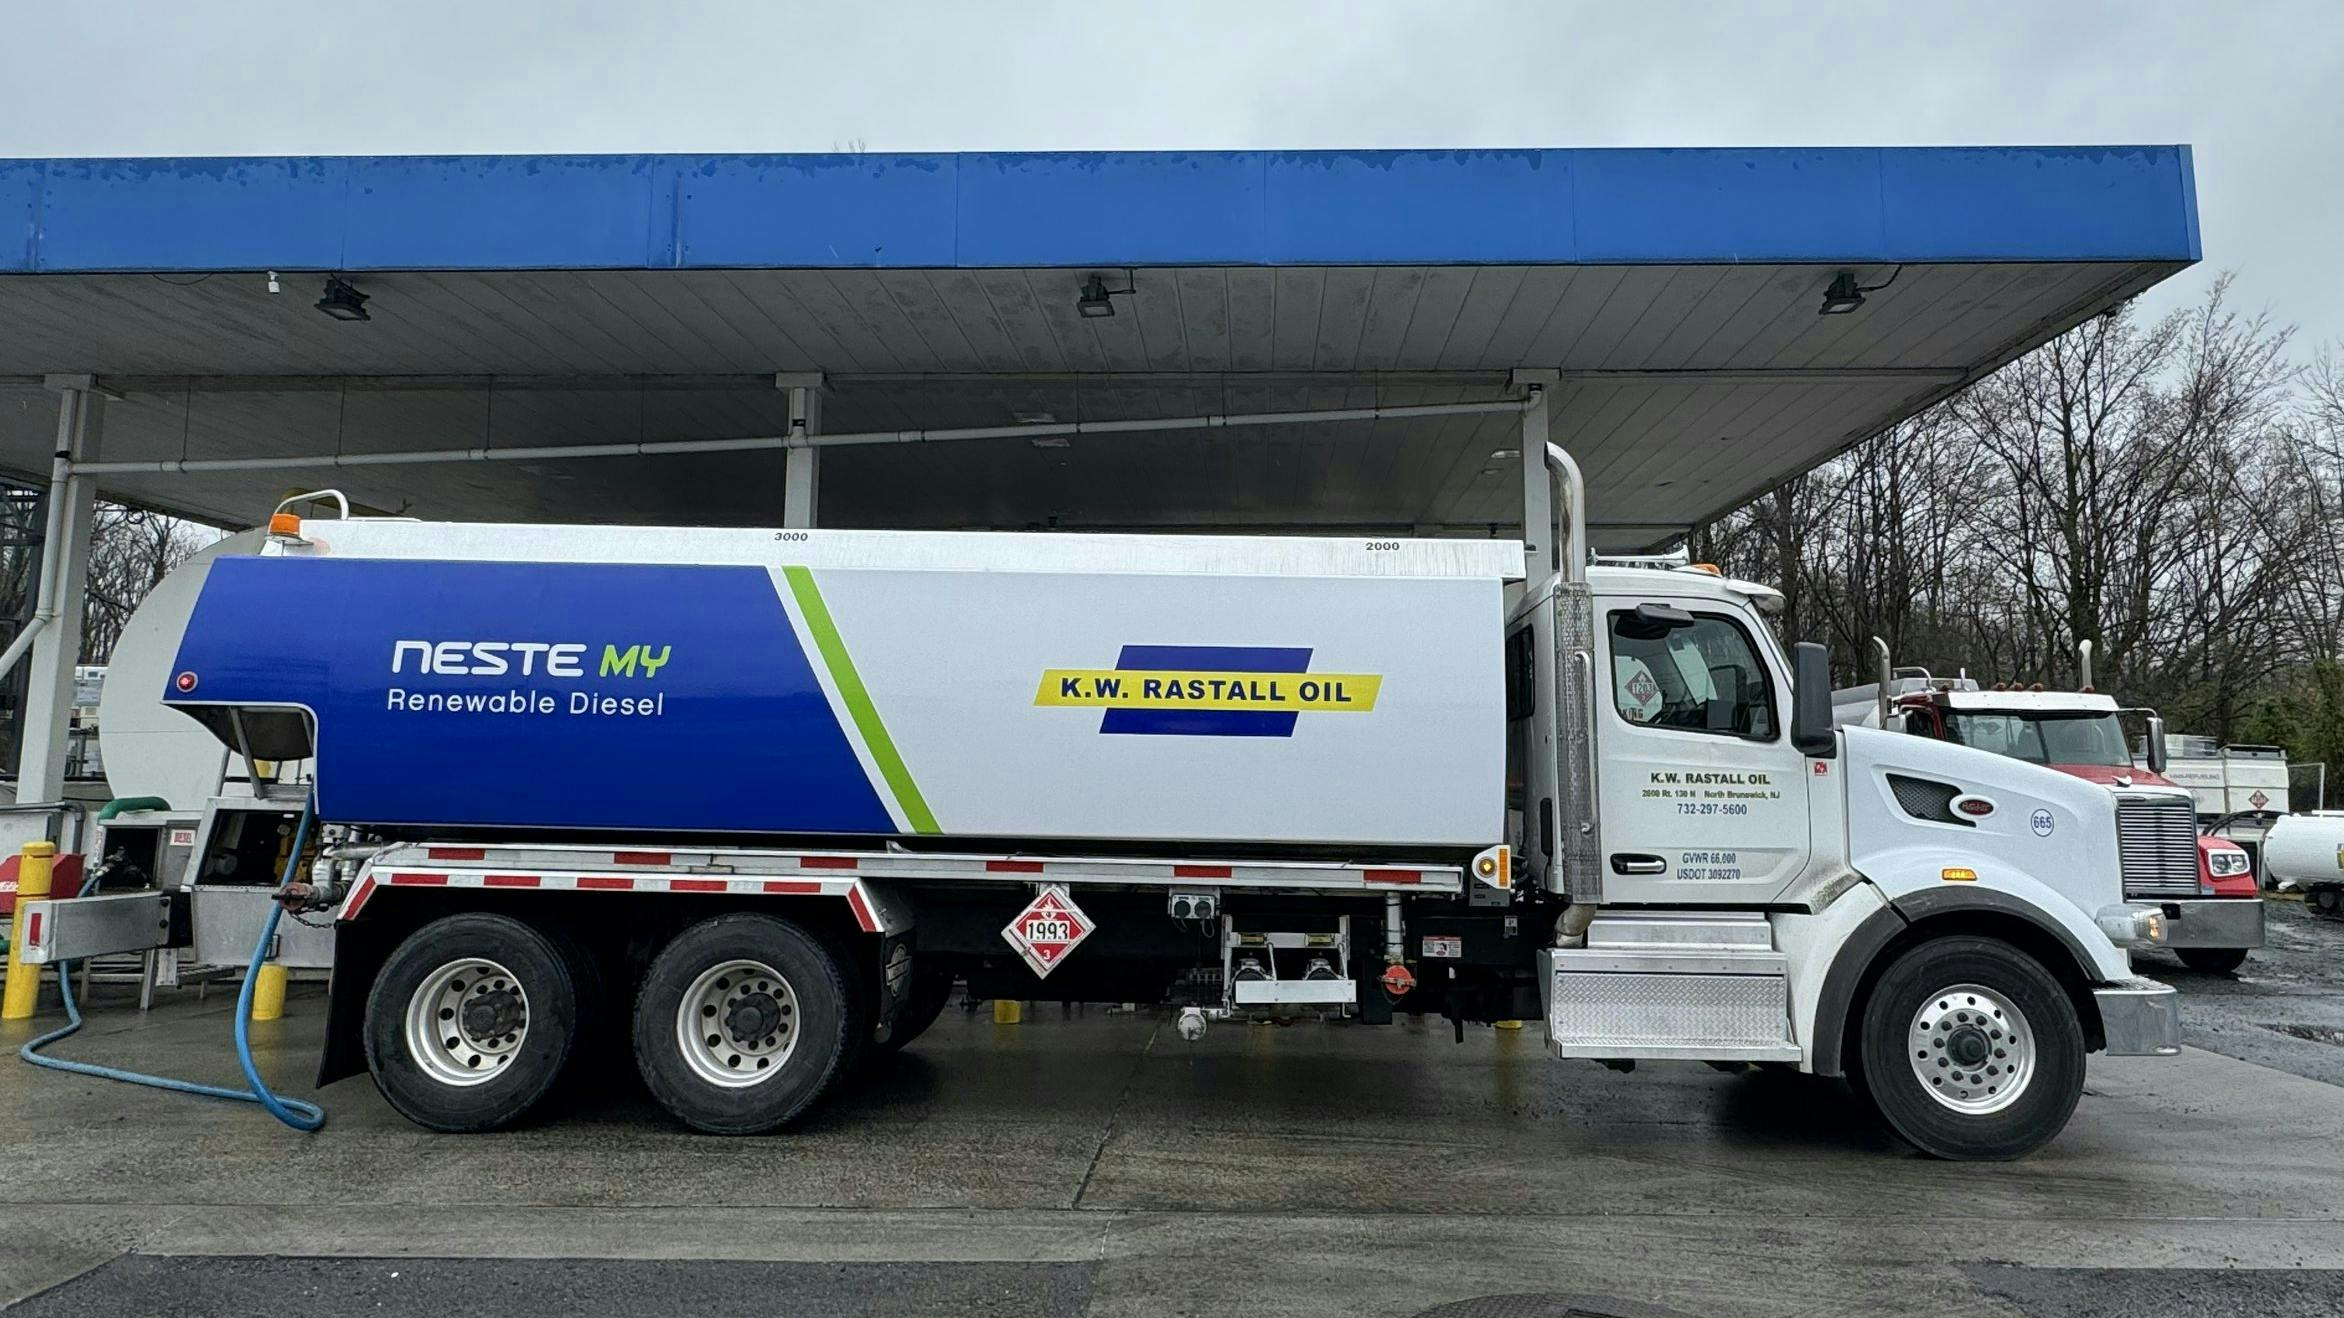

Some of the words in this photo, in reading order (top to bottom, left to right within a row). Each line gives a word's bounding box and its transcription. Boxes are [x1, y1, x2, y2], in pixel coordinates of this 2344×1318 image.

[774, 532, 809, 541] 3000
[1365, 542, 1400, 551] 2000
[391, 640, 588, 677] NESTE
[599, 644, 672, 678] MY
[1061, 678, 1128, 699] K.W.
[1143, 679, 1286, 702] RASTALL
[1299, 682, 1351, 702] OIL
[387, 689, 555, 714] Renewable
[569, 692, 664, 716] Diesel
[1650, 773, 1680, 783] K.W.
[1685, 773, 1745, 785] RASTALL
[1748, 774, 1770, 785] OIL
[1704, 790, 1725, 798] North
[1770, 791, 1780, 799] NJ
[1677, 803, 1748, 815] 732-297-5600
[2033, 816, 2052, 829] 665
[1682, 852, 1709, 864] GVWR
[1677, 868, 1706, 880] USDOT
[1708, 868, 1741, 880] 3092270
[1028, 922, 1068, 940] 1993
[1043, 949, 1051, 960] 3
